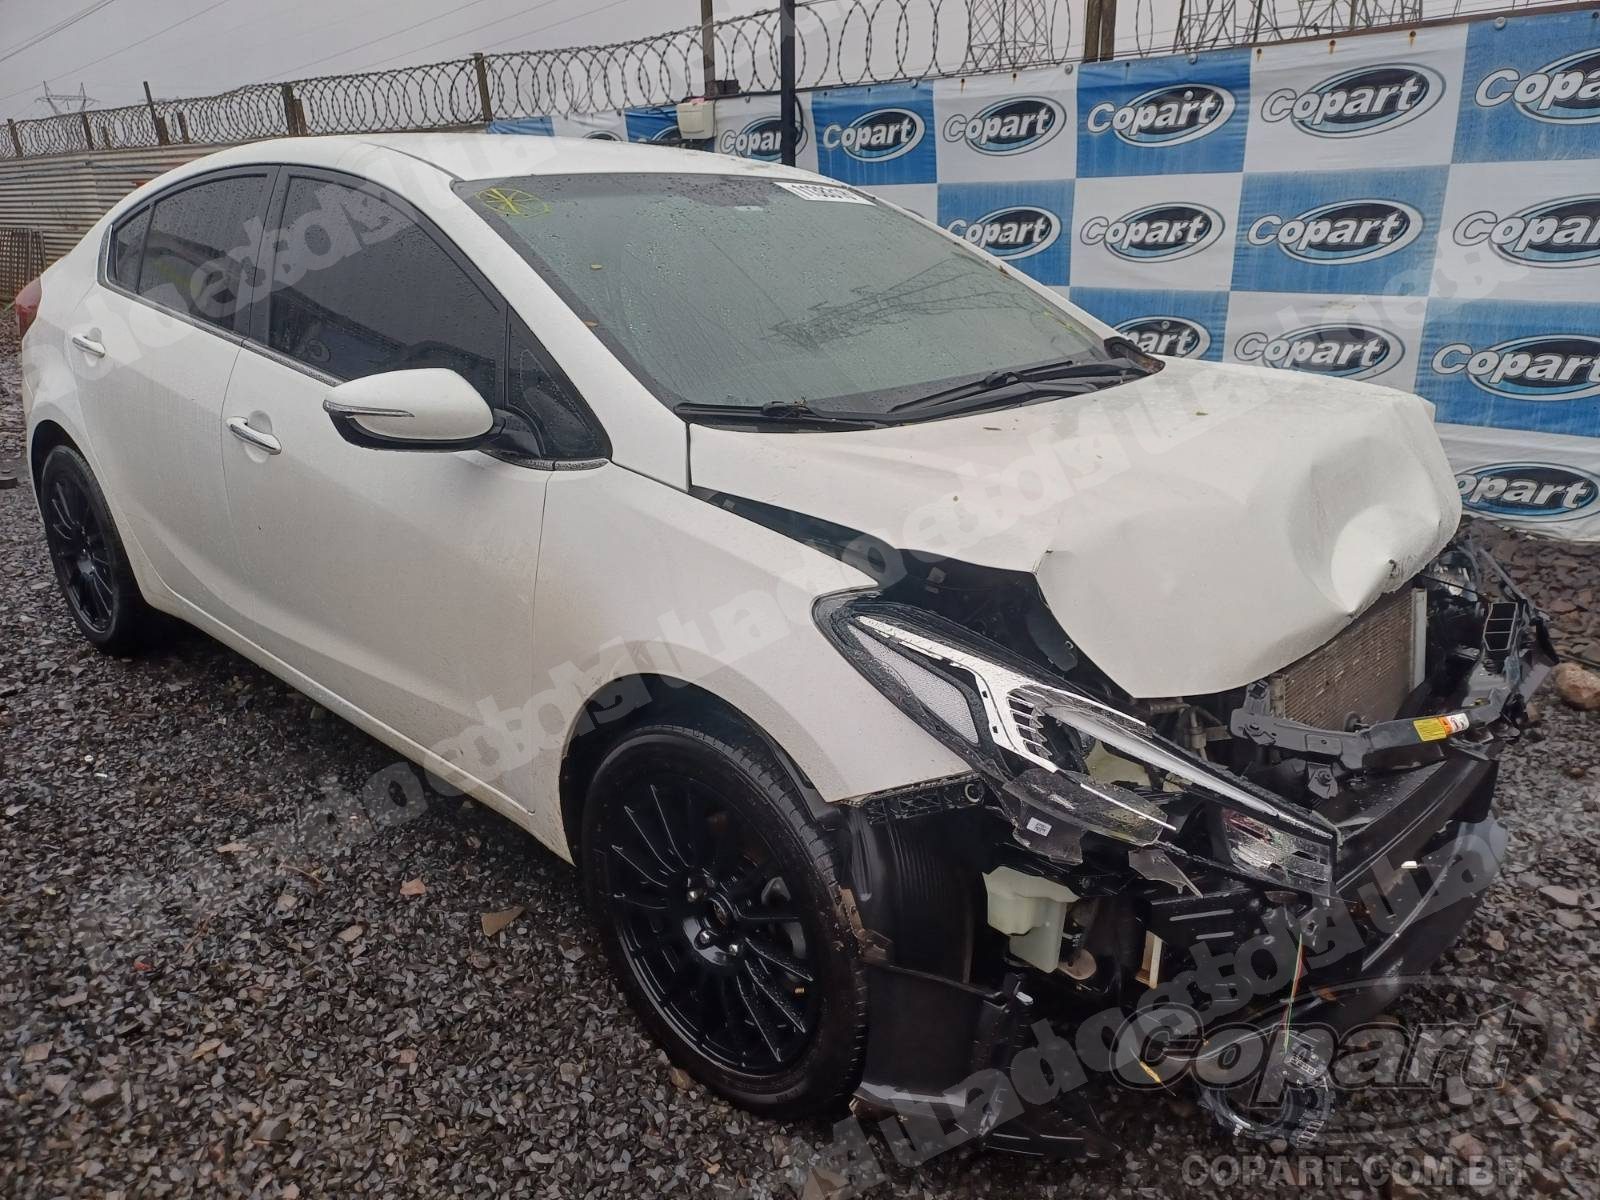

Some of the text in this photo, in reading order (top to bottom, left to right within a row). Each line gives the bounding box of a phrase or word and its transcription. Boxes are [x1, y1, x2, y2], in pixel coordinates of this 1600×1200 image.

[1261, 77, 1421, 125] Copart
[1475, 67, 1600, 111] Copa
[823, 117, 912, 151] Copart
[942, 107, 1049, 145] Copart
[1088, 94, 1216, 136] Copart
[946, 216, 1047, 249] Copart
[1080, 213, 1205, 250] Copart
[1247, 211, 1403, 251] Copart
[1453, 210, 1600, 252] Copa
[1234, 332, 1382, 368] Copart
[1455, 473, 1590, 509] opart
